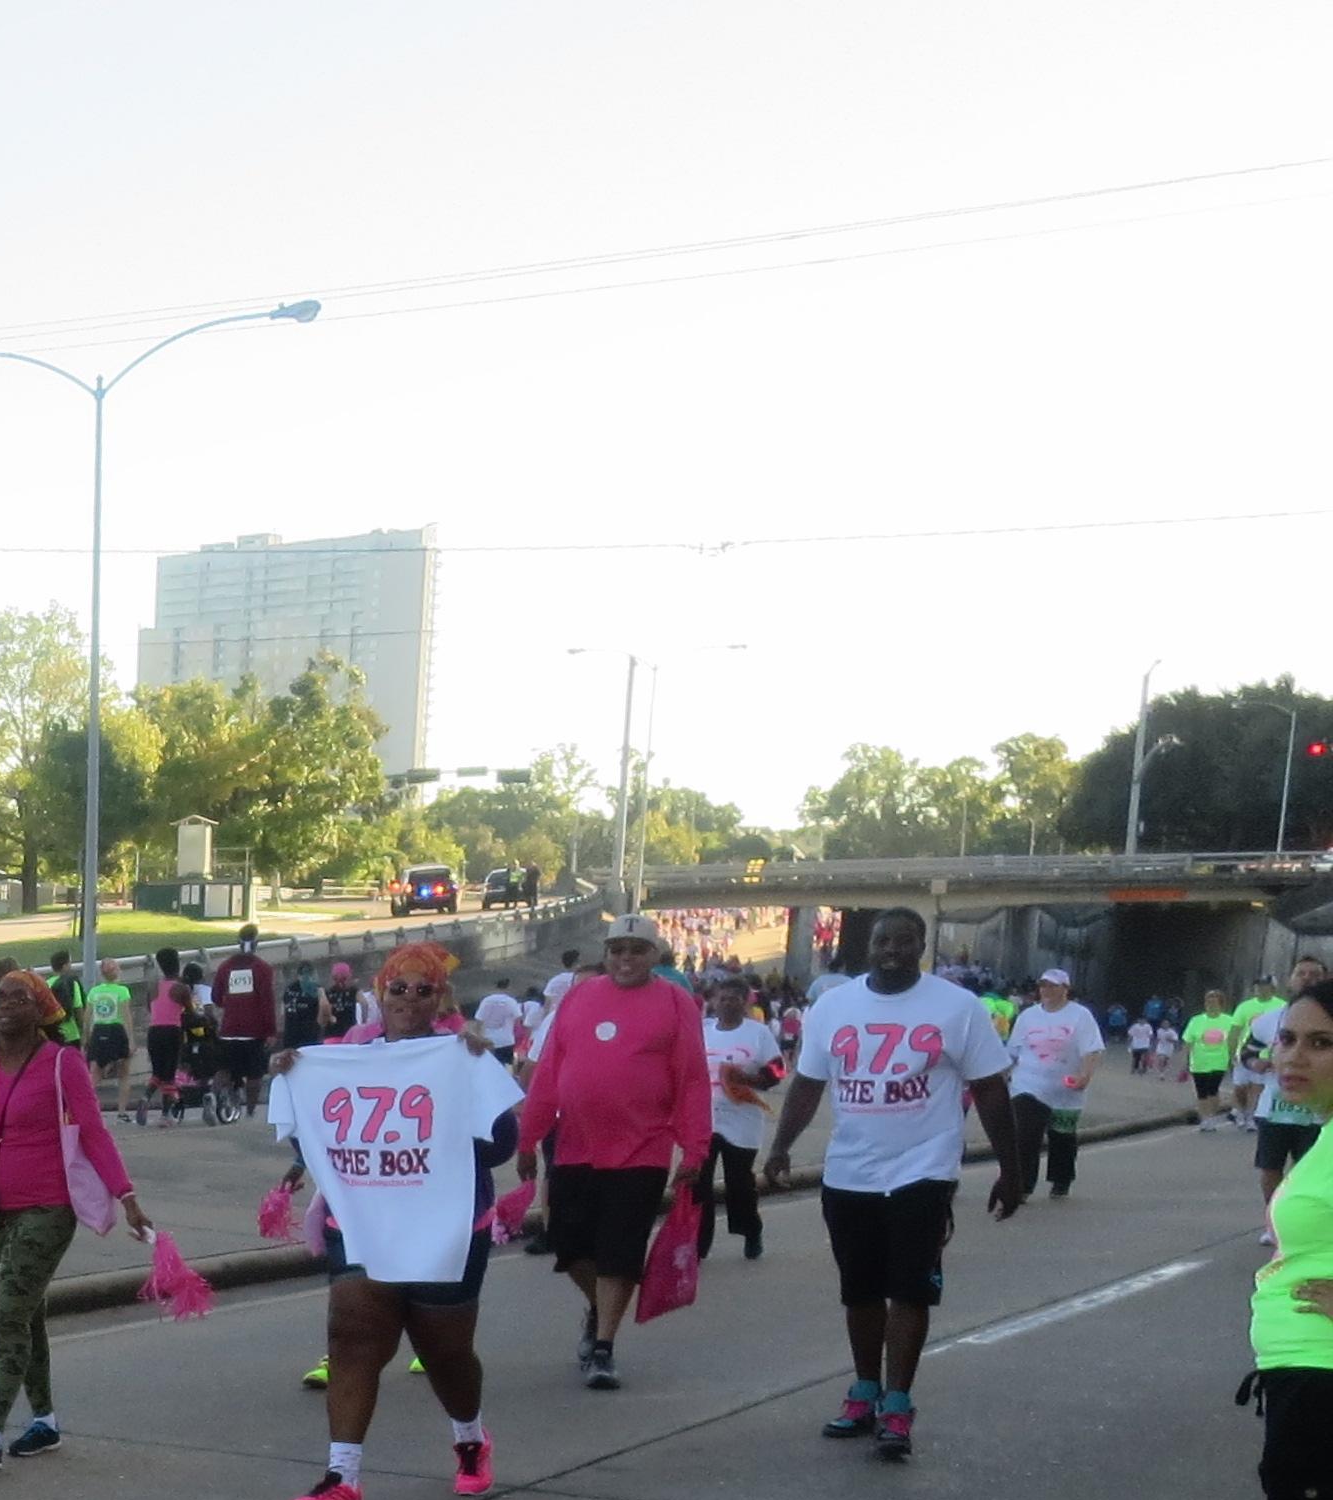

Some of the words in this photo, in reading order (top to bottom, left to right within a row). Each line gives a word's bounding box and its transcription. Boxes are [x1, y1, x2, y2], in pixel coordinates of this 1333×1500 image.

[624, 917, 640, 933] T
[831, 1023, 944, 1075] 97.9
[838, 1079, 875, 1104] THE
[884, 1074, 931, 1104] BOX
[322, 1084, 434, 1145] 97.9
[326, 1146, 370, 1176] THE
[379, 1147, 431, 1177] BOX
